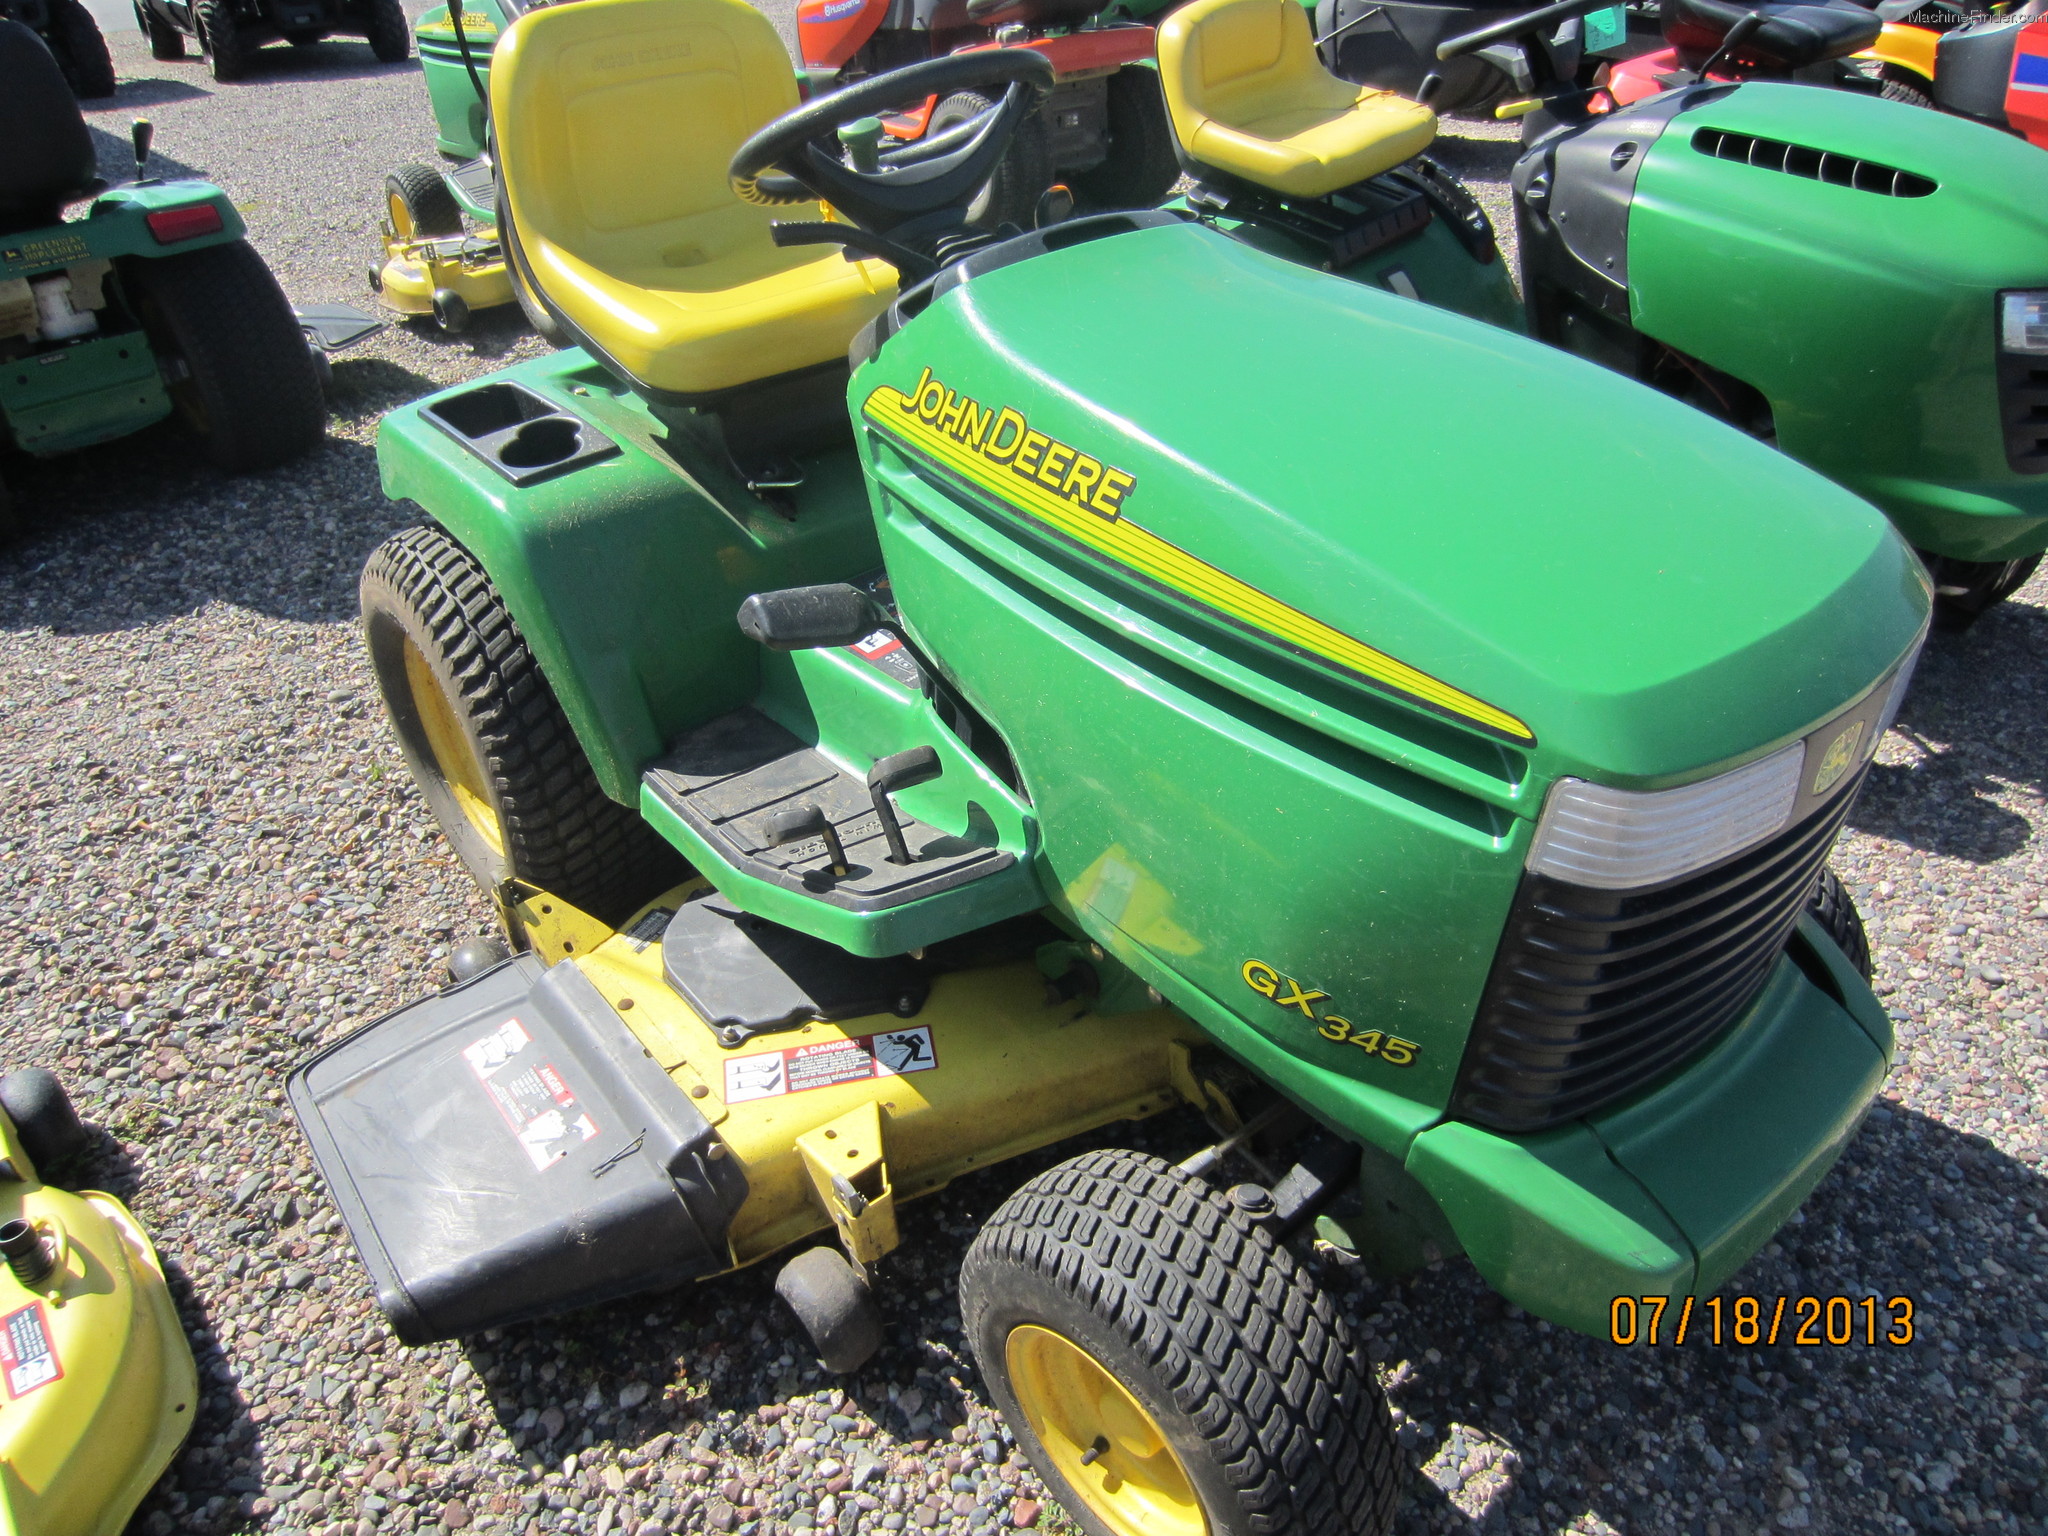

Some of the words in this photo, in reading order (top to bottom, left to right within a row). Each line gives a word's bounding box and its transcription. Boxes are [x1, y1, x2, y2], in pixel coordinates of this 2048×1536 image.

[900, 365, 995, 452] JOHN
[983, 405, 1137, 525] DEERE
[809, 1039, 860, 1054] DANGER
